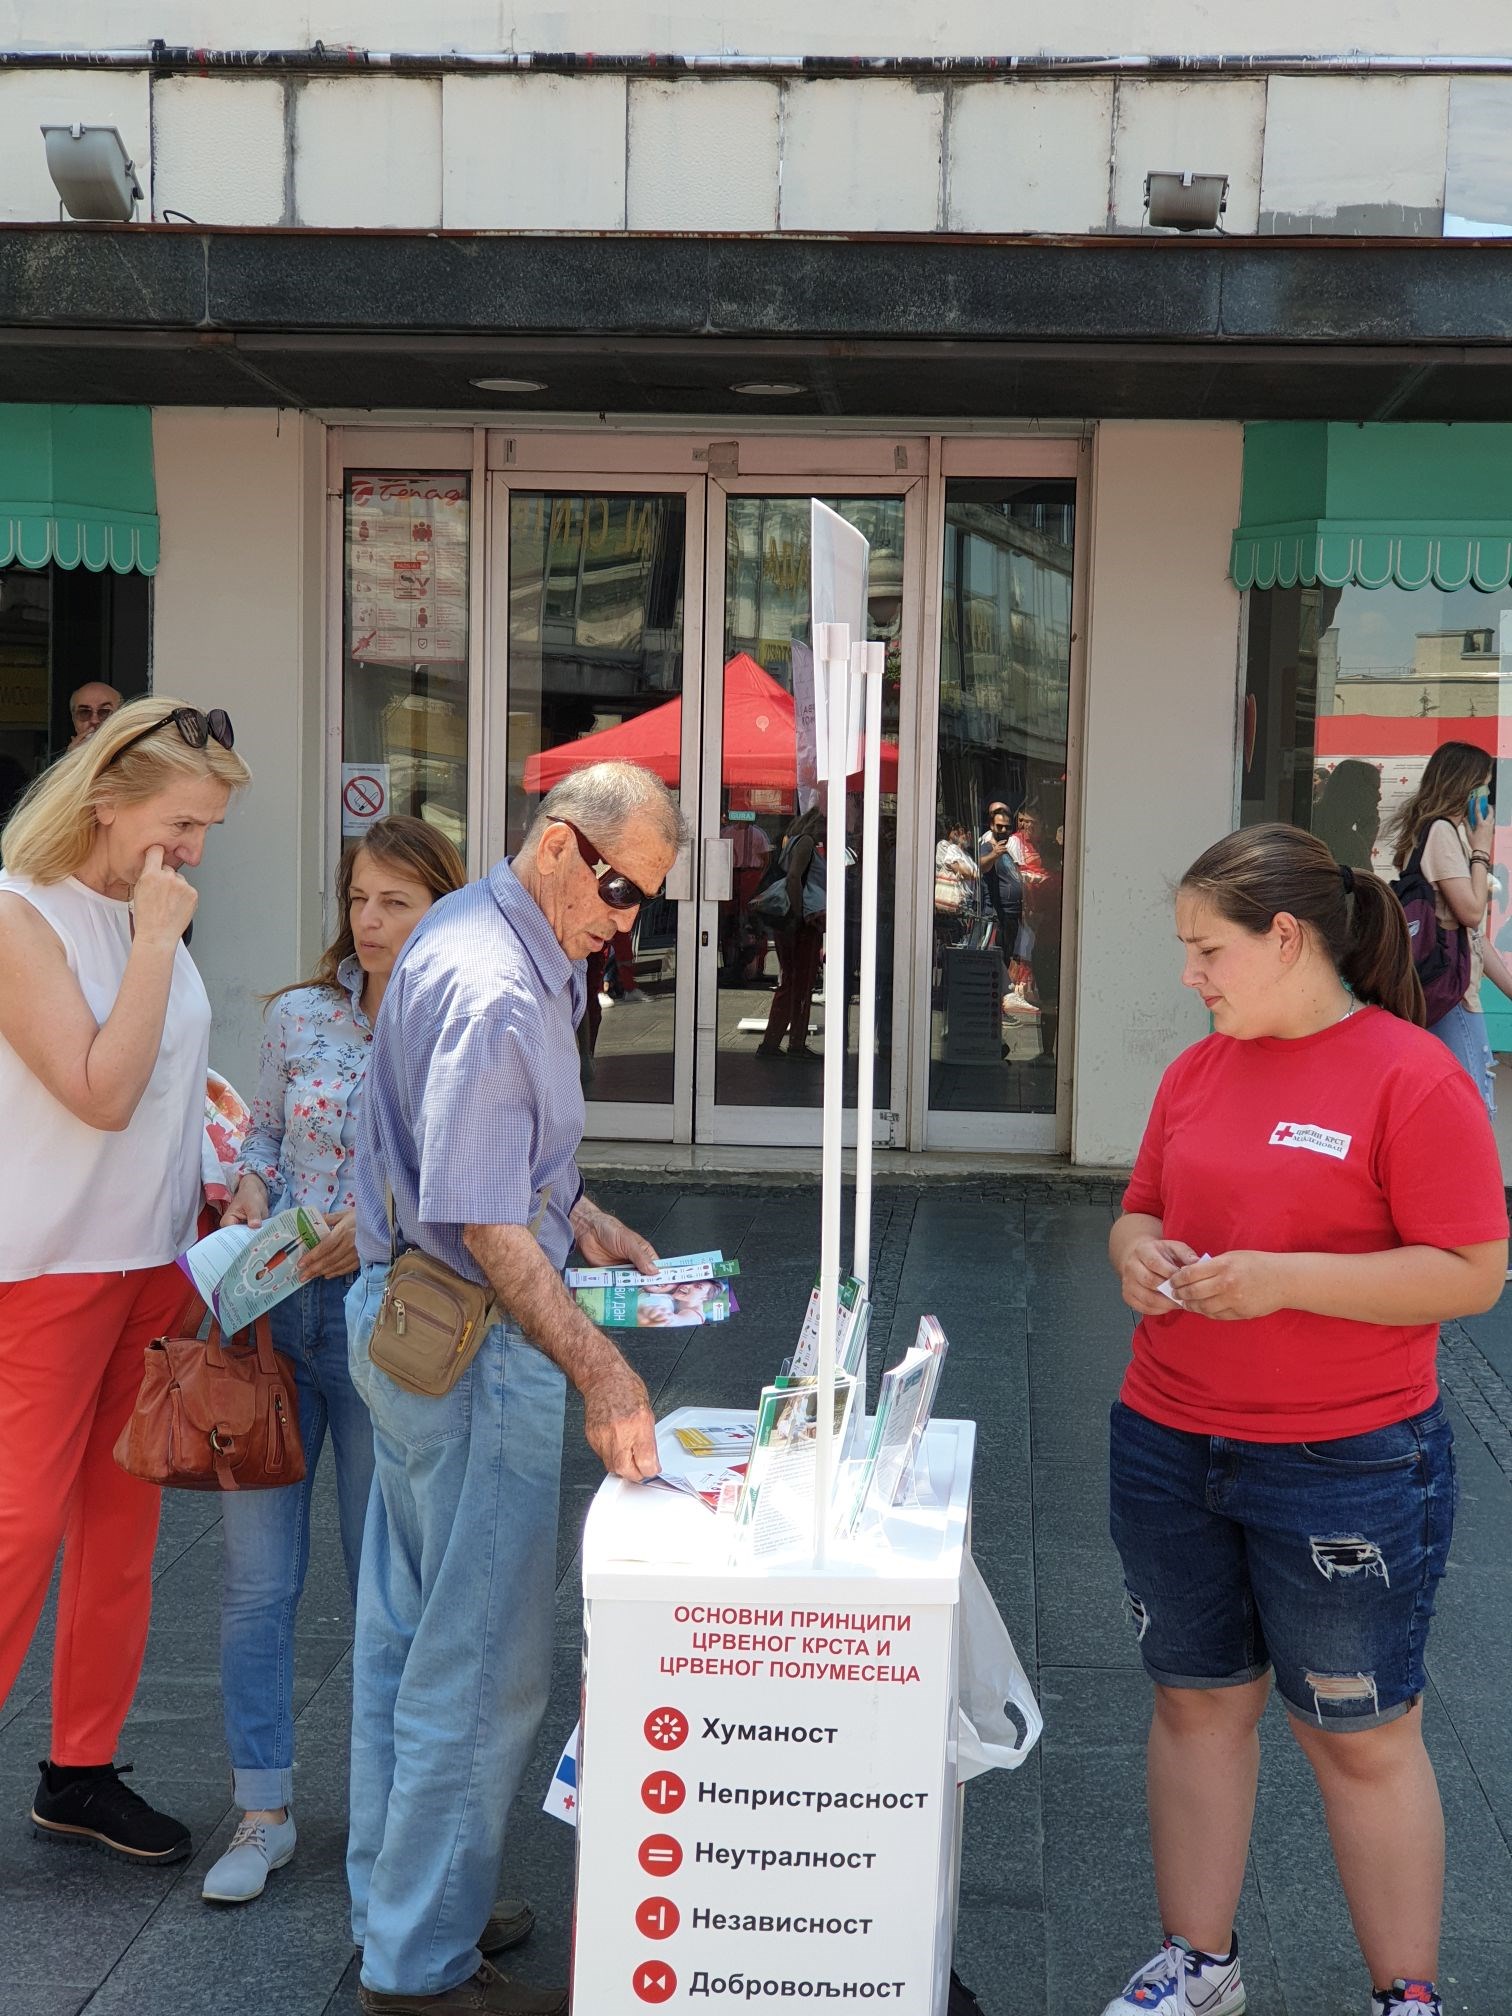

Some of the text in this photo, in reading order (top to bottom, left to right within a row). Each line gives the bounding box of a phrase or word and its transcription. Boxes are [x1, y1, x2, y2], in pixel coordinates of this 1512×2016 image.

[1325, 1135, 1345, 1146] КРСТ
[674, 1605, 911, 1634] ОСНОВНИ ПРИНЦИПИ
[692, 1631, 891, 1657] ЦРВЕНОГ КРСТА И
[660, 1656, 921, 1685] ЦРВЕНОГ ПОЛУМЕСЕЦА
[701, 1717, 839, 1746] Хуманост
[698, 1781, 929, 1813] Непристрасност
[695, 1841, 877, 1871] Неутралност
[692, 1907, 874, 1935] Независност
[688, 1971, 906, 2001] Добровољност
